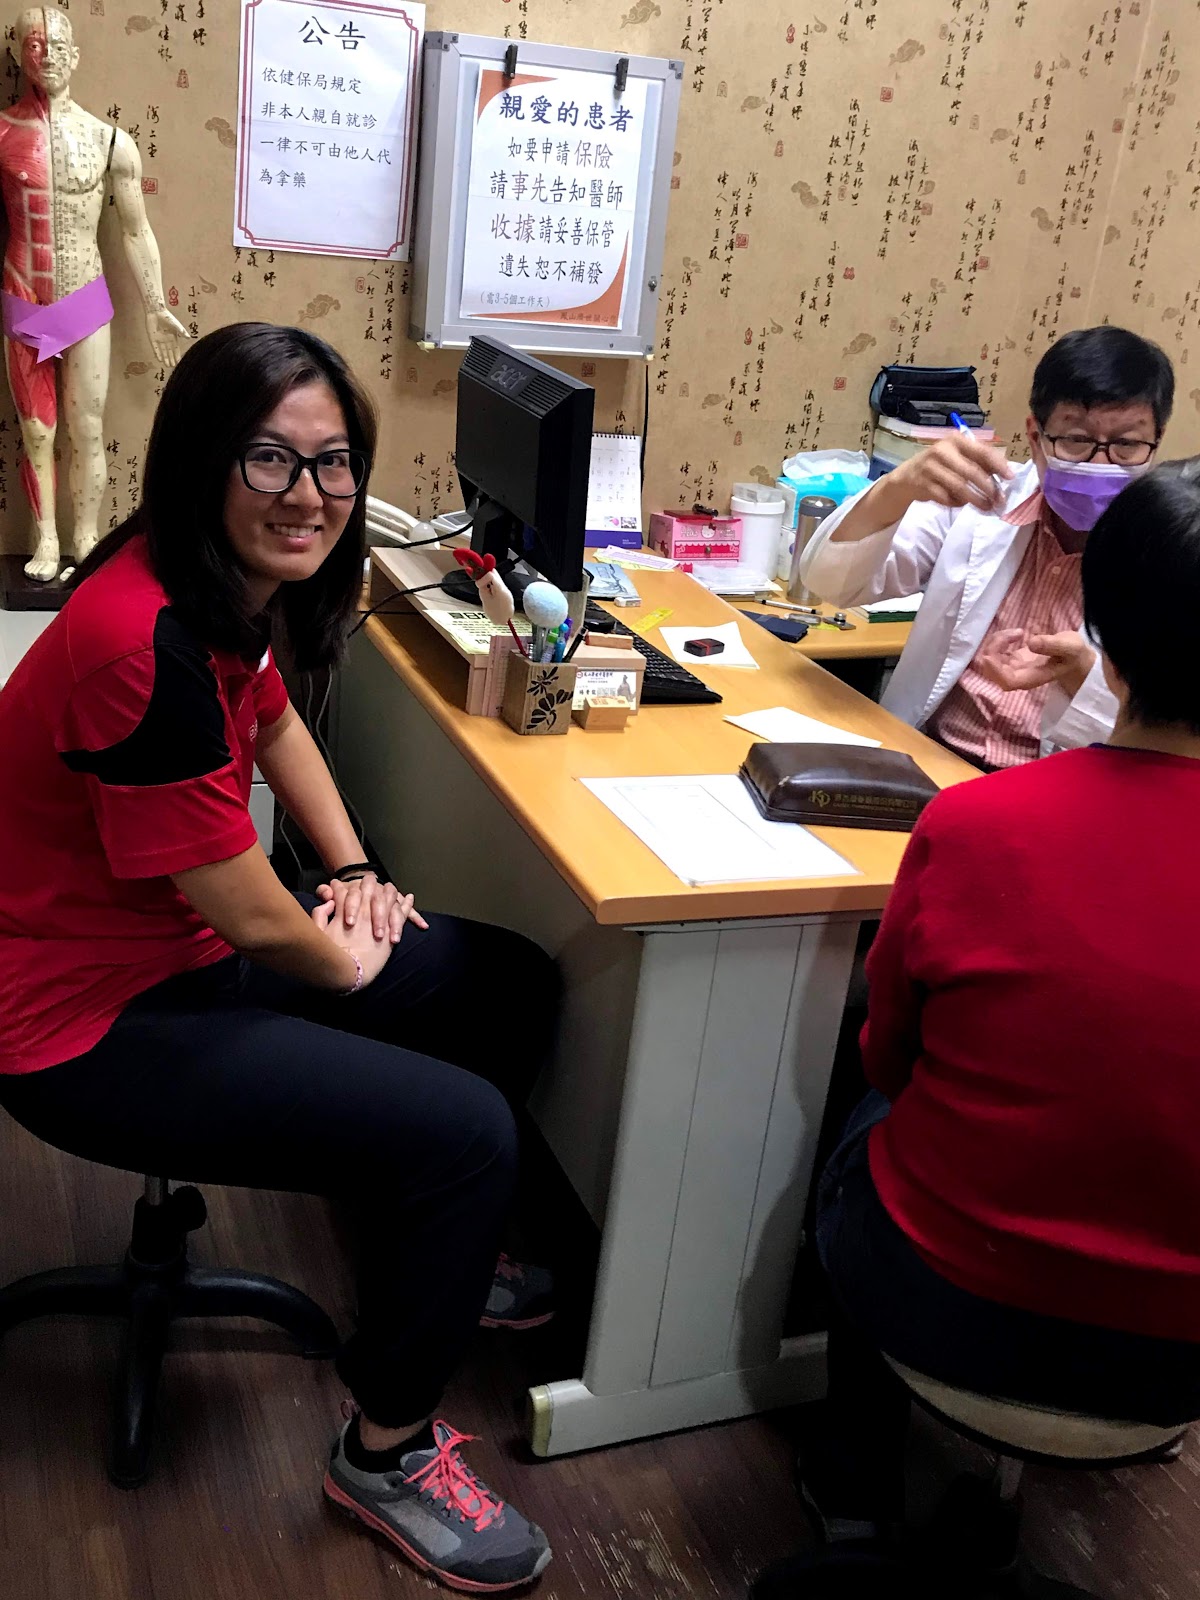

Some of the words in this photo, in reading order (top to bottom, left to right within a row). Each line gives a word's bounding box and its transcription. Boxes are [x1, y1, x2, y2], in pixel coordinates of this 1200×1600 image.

[298, 15, 366, 50] 公告
[262, 67, 362, 95] 依健保局規定
[260, 101, 378, 130] 非本人親自就診
[499, 92, 634, 133] 親愛的患者
[260, 136, 392, 165] 一律不可由他人代
[507, 136, 614, 170] 如要申請保險
[258, 168, 307, 188] 為拿藥
[490, 171, 624, 211] 請事先告知醫師
[490, 212, 615, 249] 收據請妥善保管
[498, 255, 604, 286] 遺失恕不補發
[490, 364, 528, 391] acer
